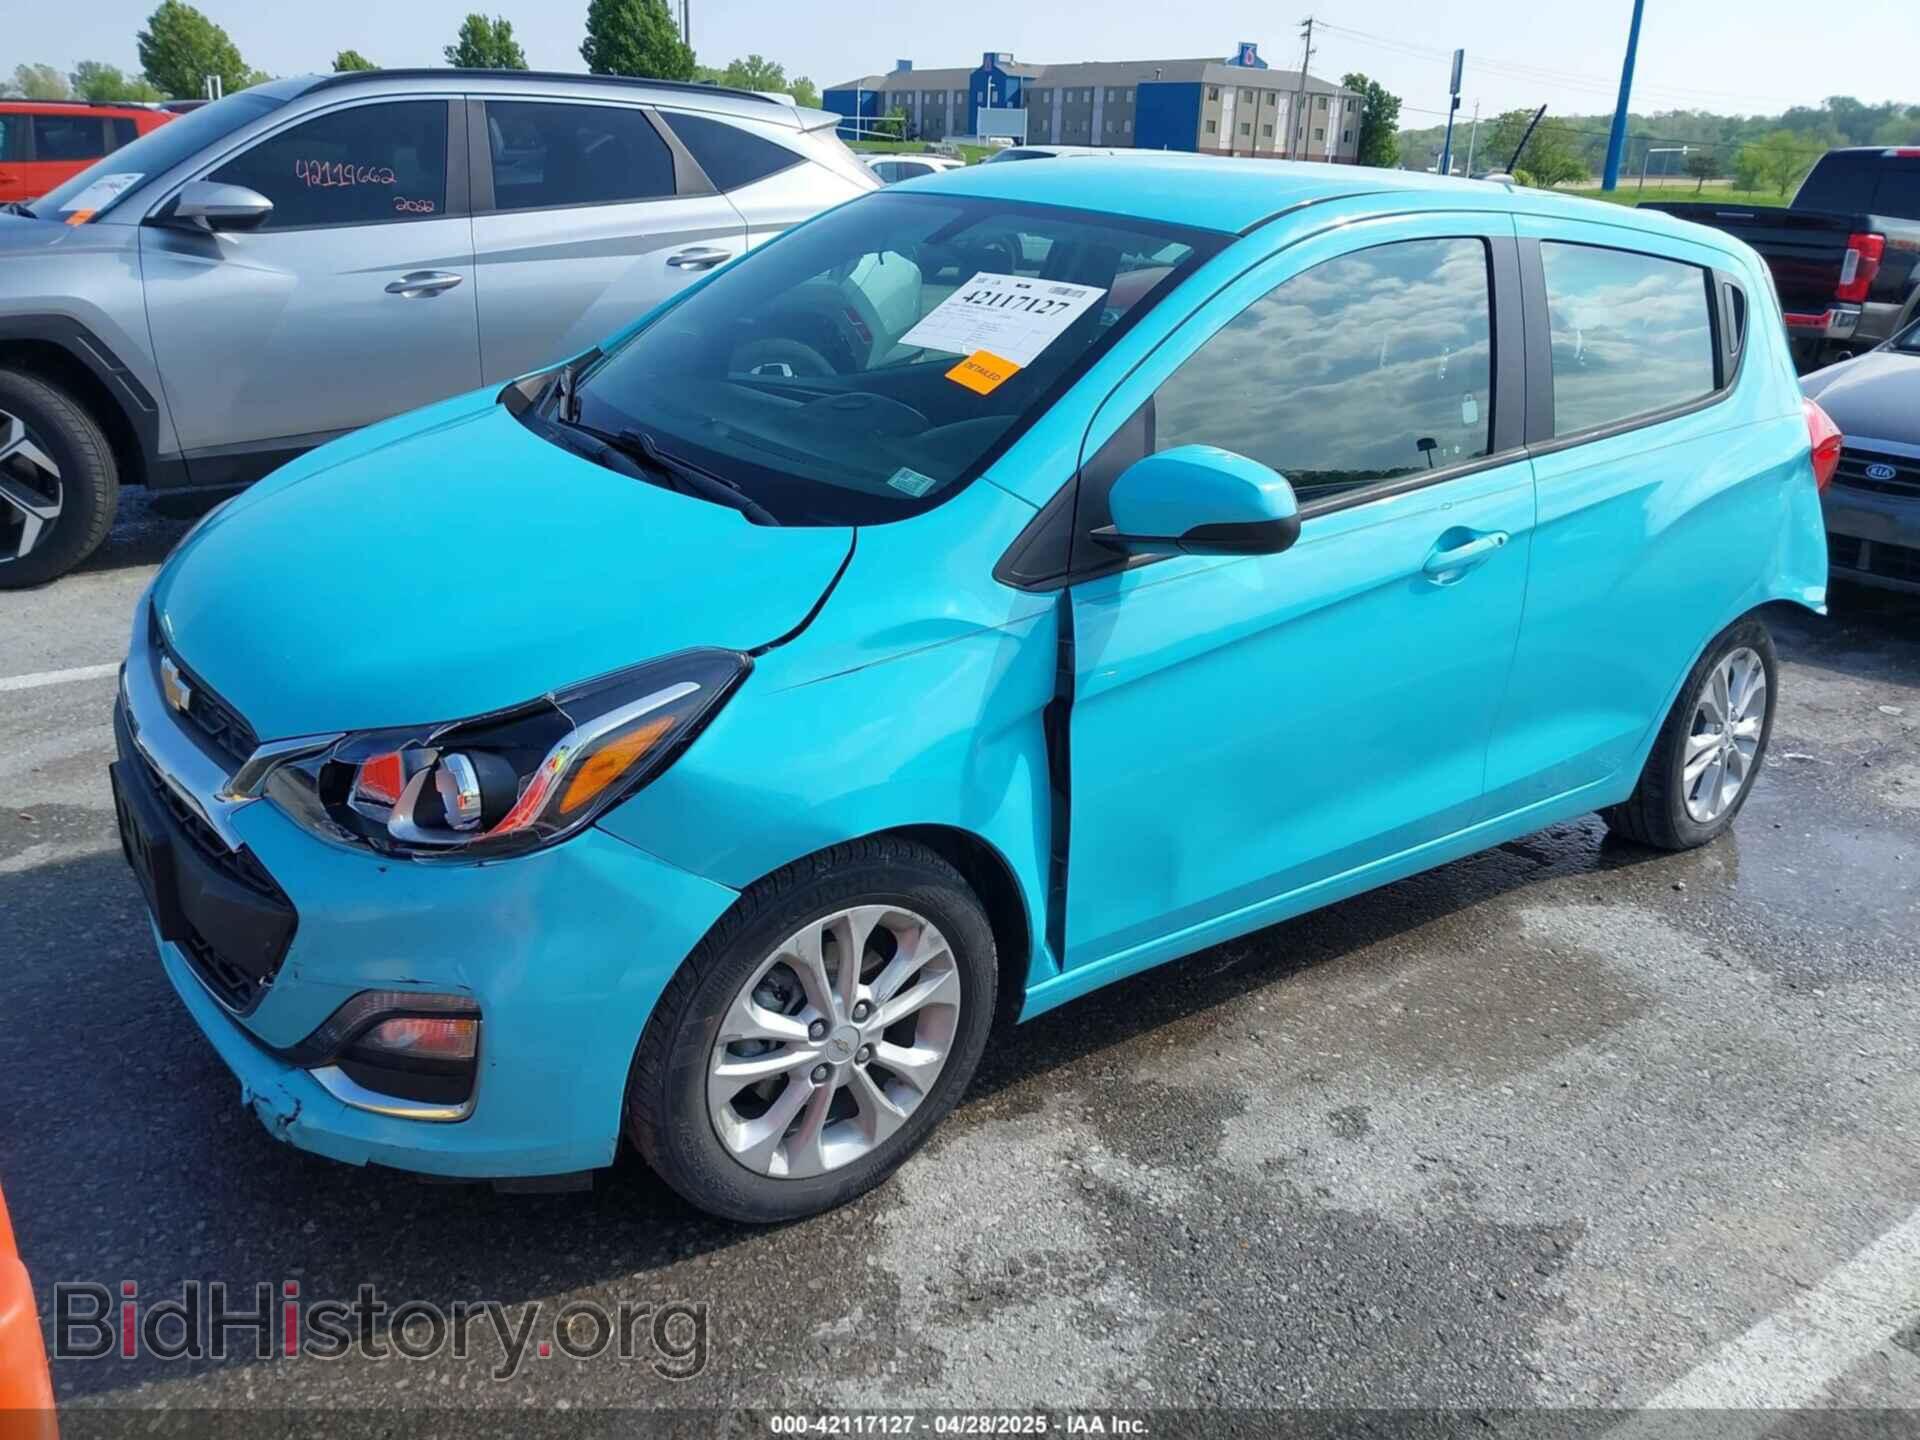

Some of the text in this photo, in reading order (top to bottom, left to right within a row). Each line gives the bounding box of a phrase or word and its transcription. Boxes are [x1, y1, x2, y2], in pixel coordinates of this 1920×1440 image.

[296, 159, 397, 187] 42119662
[393, 196, 435, 213] 2022
[962, 290, 1071, 315] 42117127
[964, 361, 1001, 381] DETAILED
